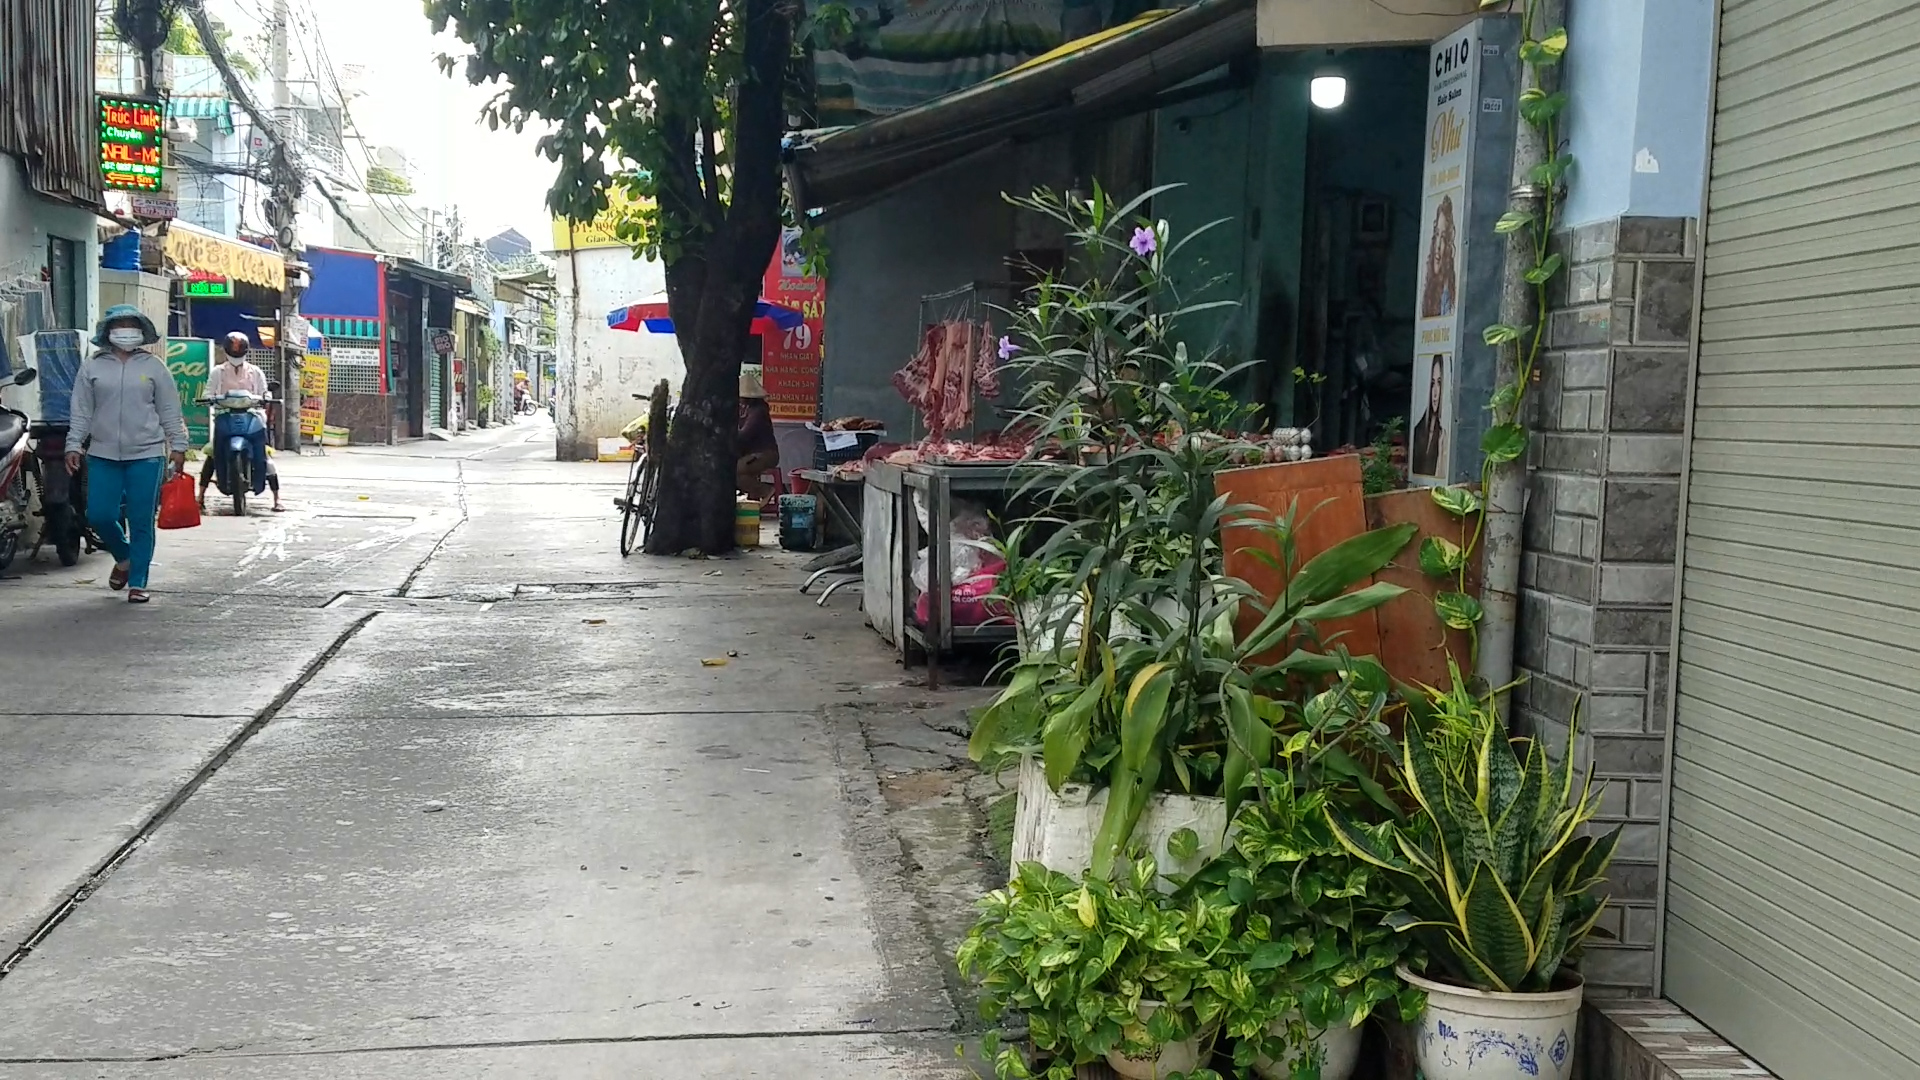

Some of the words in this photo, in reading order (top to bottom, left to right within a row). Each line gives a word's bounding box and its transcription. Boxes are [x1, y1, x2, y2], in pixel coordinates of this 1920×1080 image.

[1435, 38, 1469, 77] CHIO
[1431, 106, 1464, 163] Như
[136, 173, 153, 184] 5m
[586, 235, 606, 243] Giao
[783, 323, 812, 350] 79
